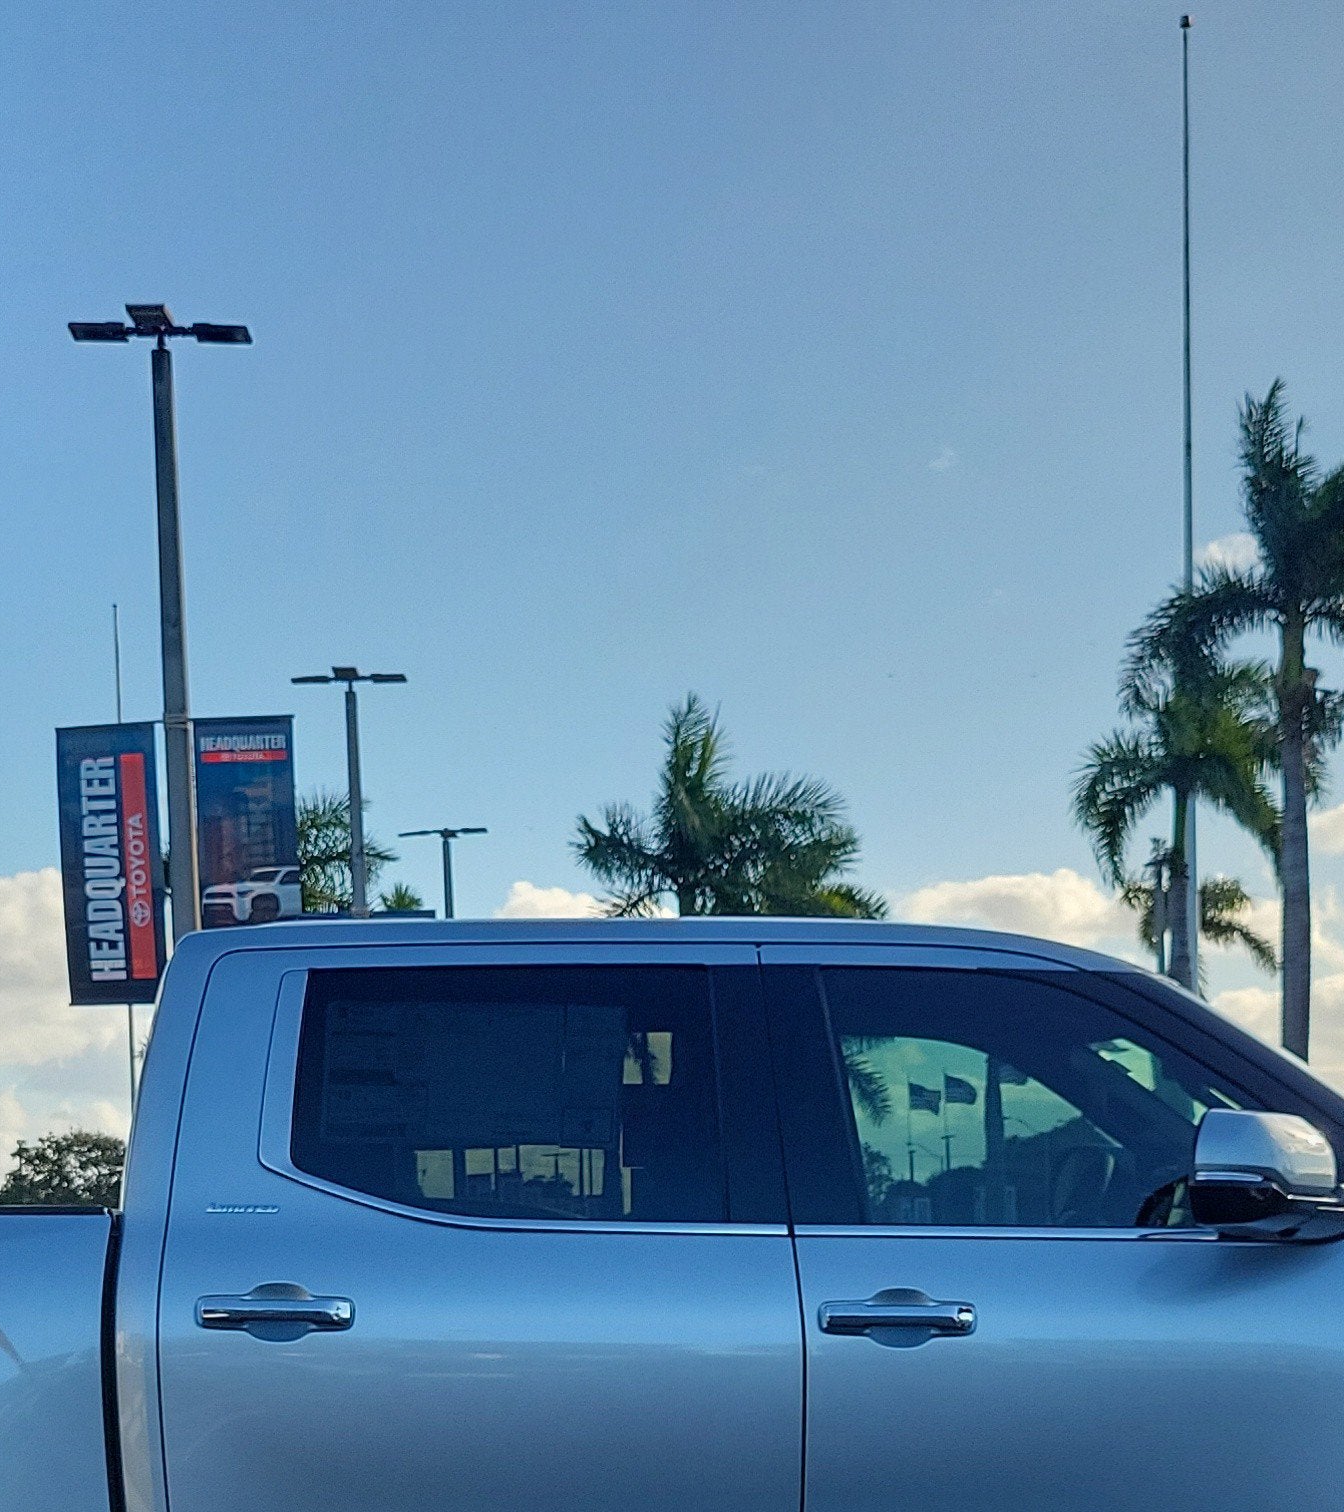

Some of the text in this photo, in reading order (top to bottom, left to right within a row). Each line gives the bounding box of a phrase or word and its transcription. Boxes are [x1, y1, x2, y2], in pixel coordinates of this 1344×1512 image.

[200, 735, 286, 751] HEADQUARTER
[80, 756, 126, 981] HEADQUARTER
[126, 814, 145, 895] TOYOTA
